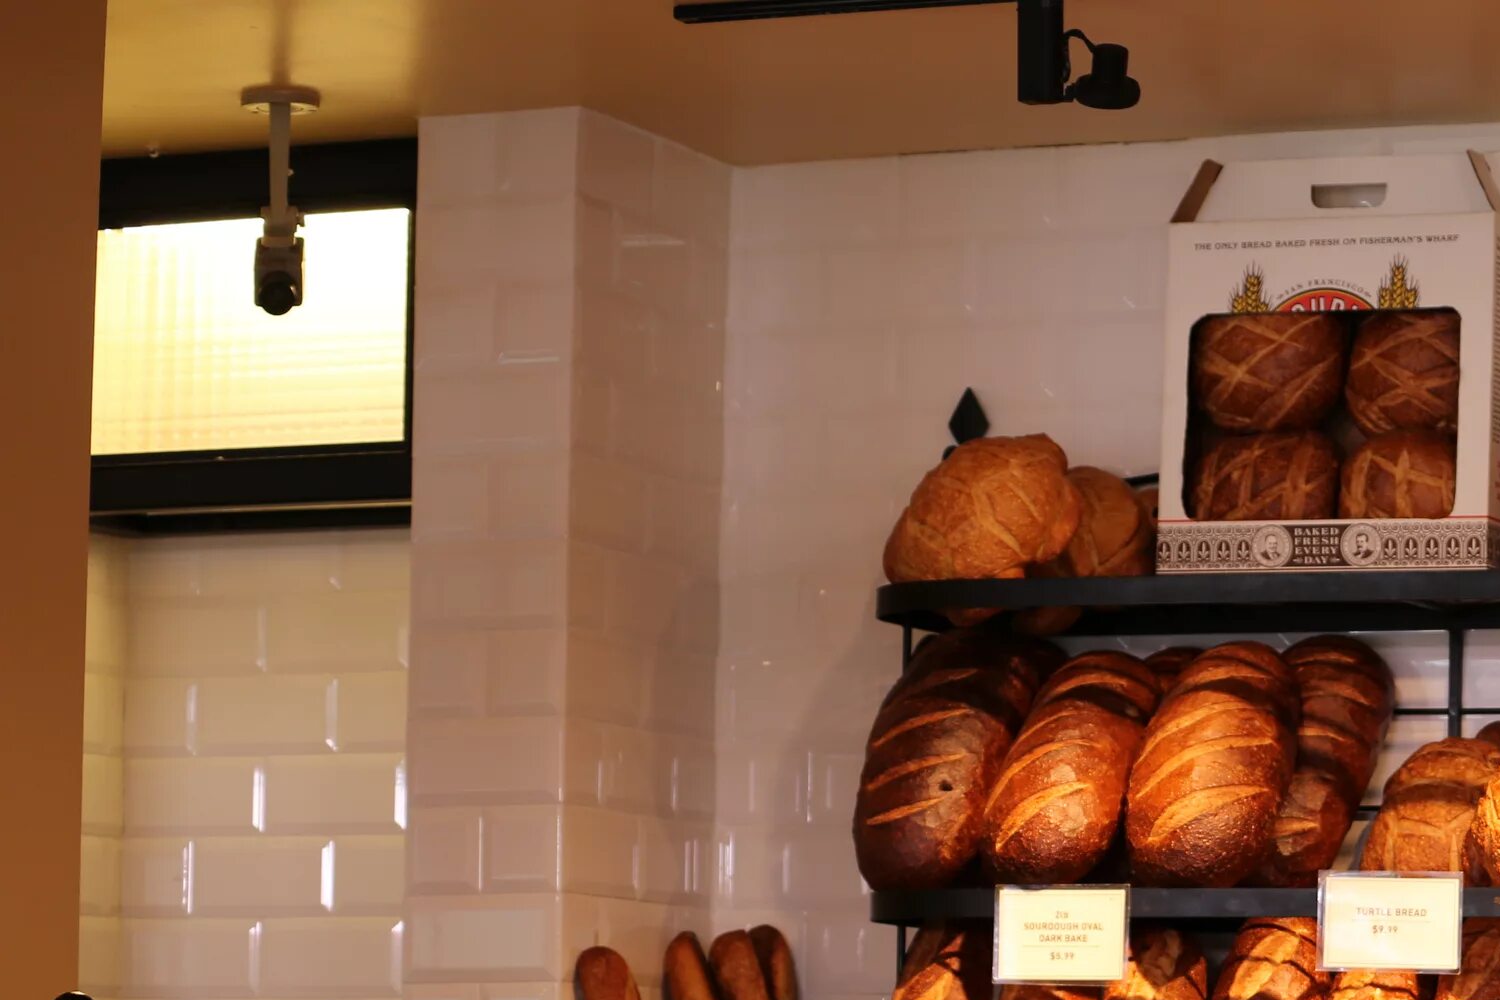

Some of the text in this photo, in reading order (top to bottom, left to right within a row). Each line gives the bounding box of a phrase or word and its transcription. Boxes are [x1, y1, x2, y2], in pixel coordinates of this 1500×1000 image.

[1215, 242, 1238, 250] ONLY
[1241, 241, 1272, 249] BREAD
[1275, 240, 1306, 248] BAKED
[1310, 238, 1340, 246] FRESH
[1343, 238, 1356, 246] ON
[1294, 527, 1340, 536] BAKED
[1294, 537, 1340, 545] FRESH
[1294, 546, 1338, 555] EVERY
[1304, 556, 1328, 564] DAY
[1356, 906, 1428, 917] TURTLE BREAD
[1024, 922, 1104, 931] SOURDOUGH OVAL
[1039, 934, 1088, 942] DARK BAKE
